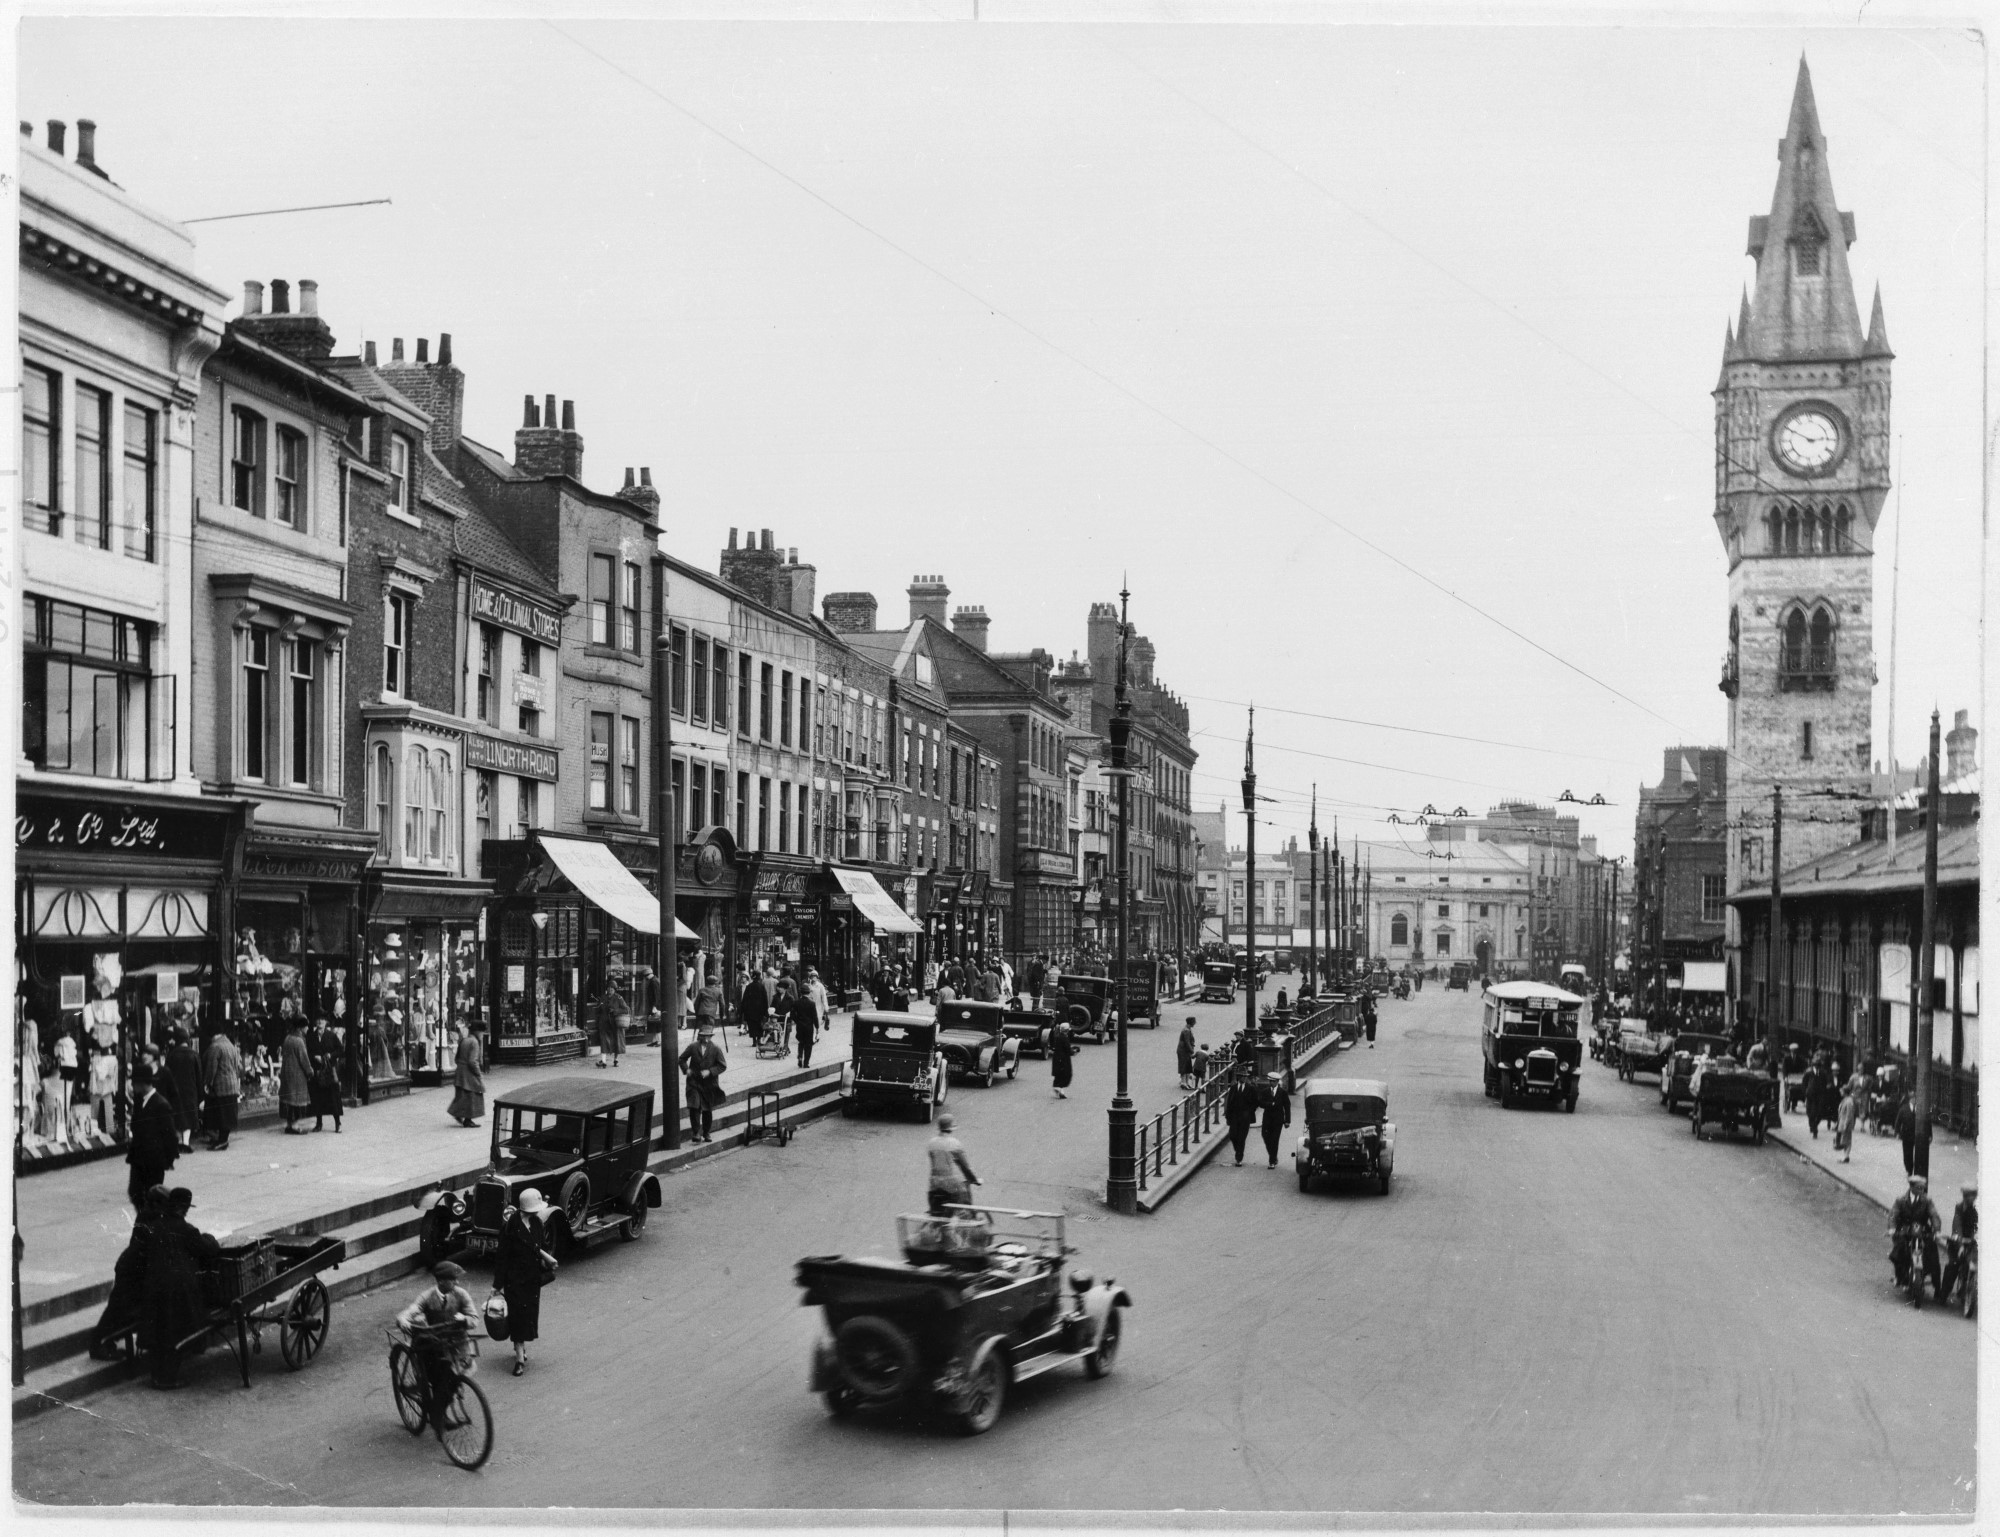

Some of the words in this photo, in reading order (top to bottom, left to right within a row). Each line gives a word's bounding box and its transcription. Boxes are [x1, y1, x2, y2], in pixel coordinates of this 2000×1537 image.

[473, 583, 494, 616] HOME
[494, 597, 499, 617] &
[499, 593, 532, 631] COLONIAL
[533, 608, 560, 641] STORES
[468, 736, 484, 748] ALSO
[486, 741, 495, 763] 11
[495, 741, 529, 770] NORTH
[530, 750, 556, 776] ROAD
[48, 817, 64, 843] &
[316, 859, 360, 879] SONS
[1115, 977, 1150, 985] LTONS
[512, 1038, 533, 1046] STORES
